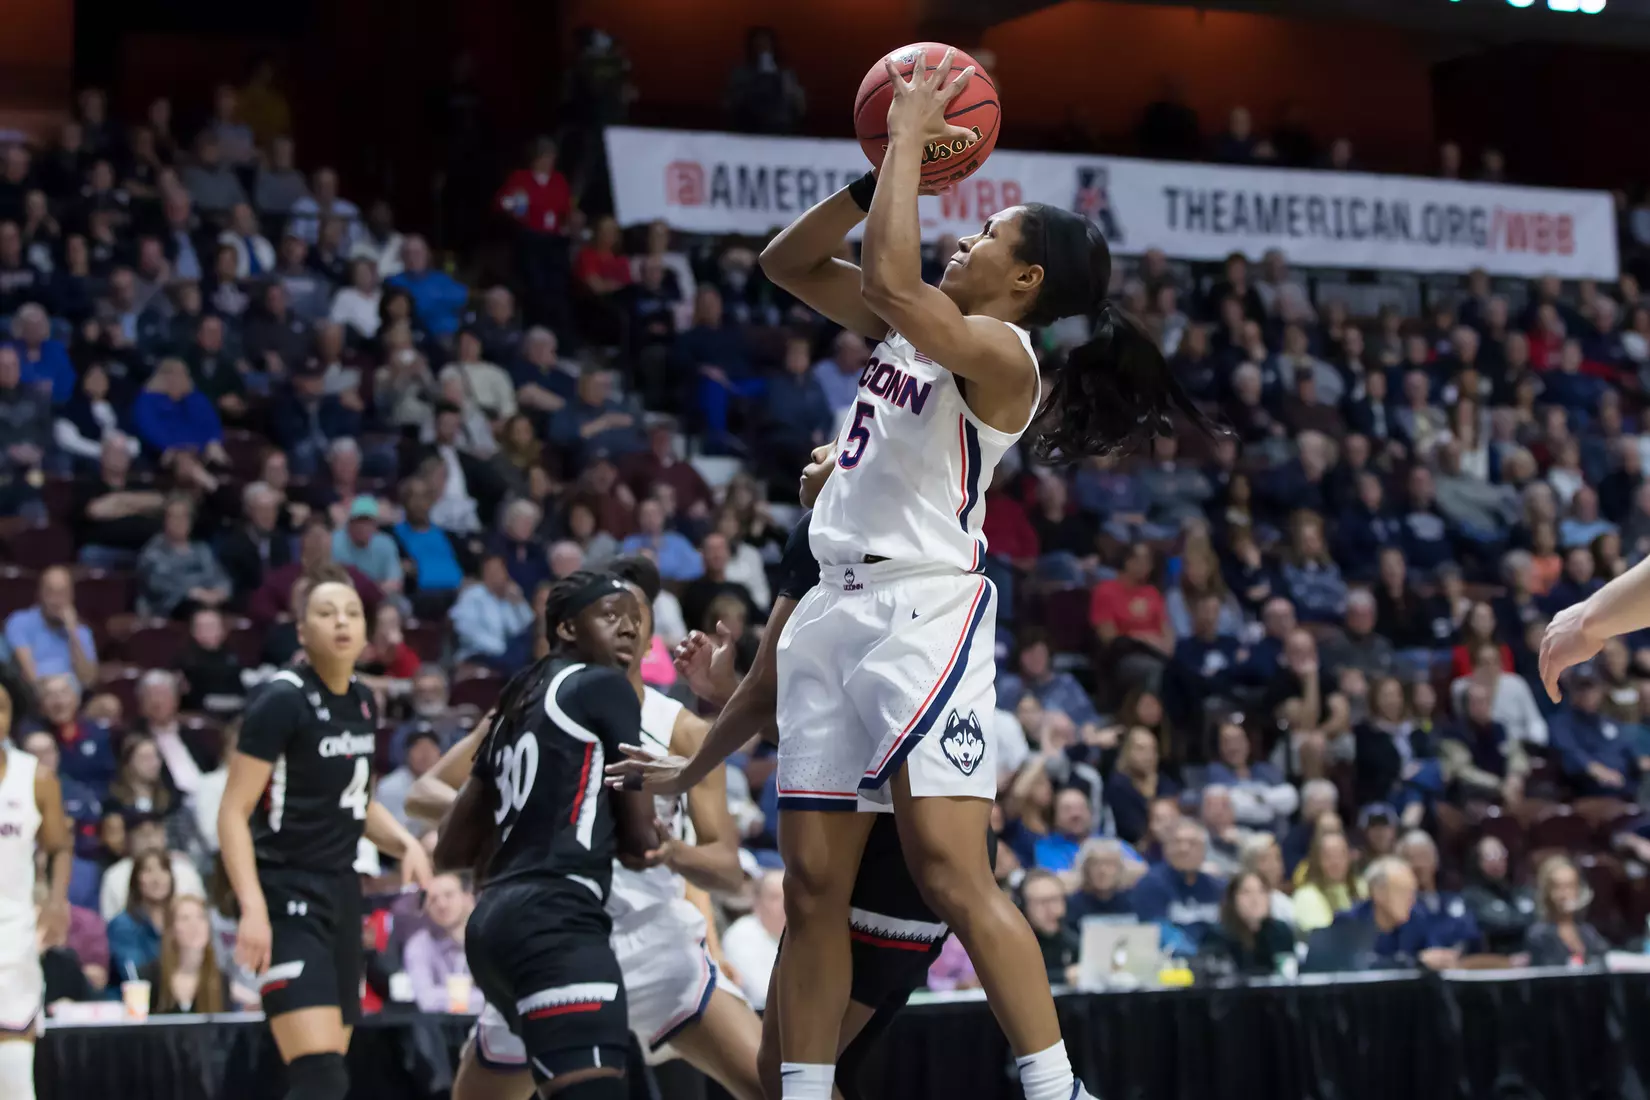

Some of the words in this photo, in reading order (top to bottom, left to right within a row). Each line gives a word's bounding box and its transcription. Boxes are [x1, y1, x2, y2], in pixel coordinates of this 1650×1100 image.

[1162, 184, 1576, 257] THEAMERICAN.ORG/WBB
[858, 356, 933, 416] CONN
[837, 400, 876, 470] 5
[339, 756, 370, 820] 4
[494, 730, 539, 826] 30
